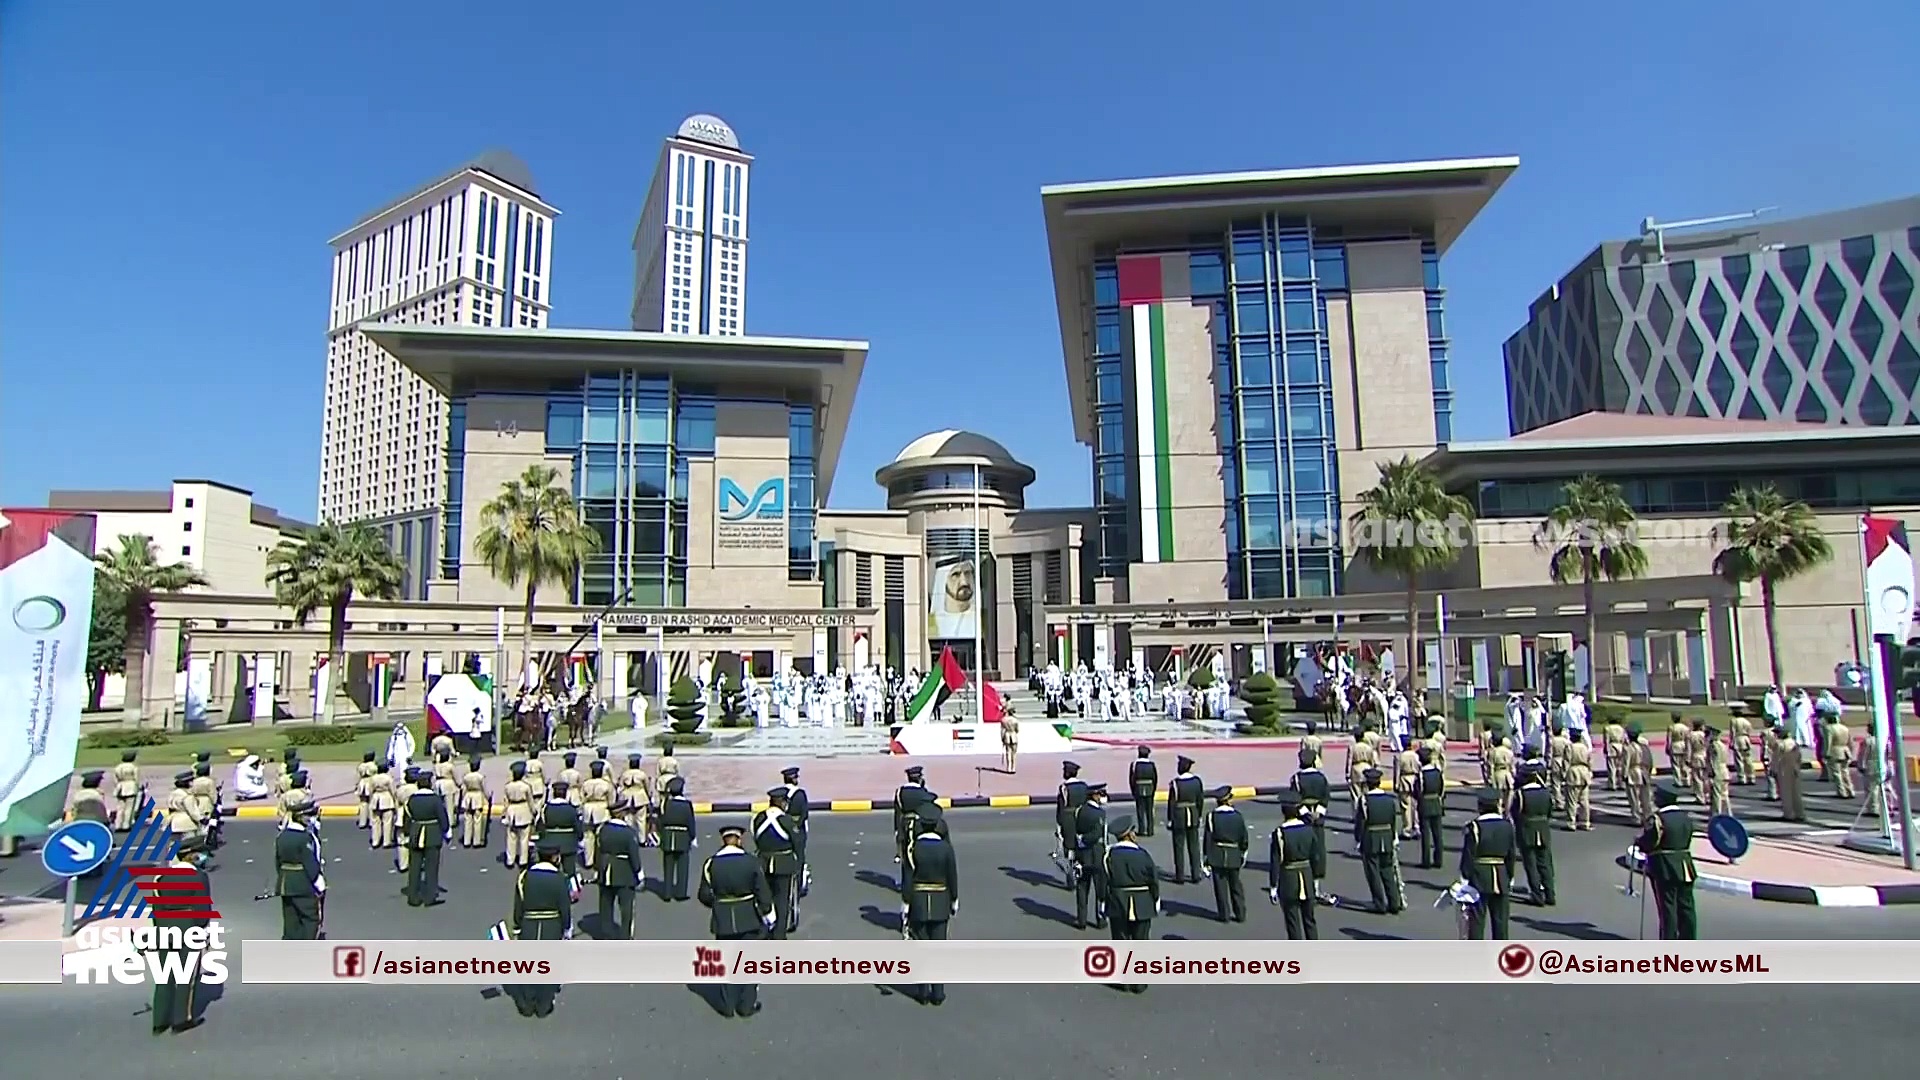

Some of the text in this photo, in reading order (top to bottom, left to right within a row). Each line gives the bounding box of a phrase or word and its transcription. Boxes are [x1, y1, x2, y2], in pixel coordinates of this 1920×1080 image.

[689, 119, 729, 136] HYATT
[495, 420, 518, 438] 14
[651, 614, 668, 625] BIN
[671, 614, 710, 625] RASHID
[713, 615, 766, 625] ACADEMIC
[769, 615, 813, 625] MEDICAL
[815, 615, 856, 625] CENTER
